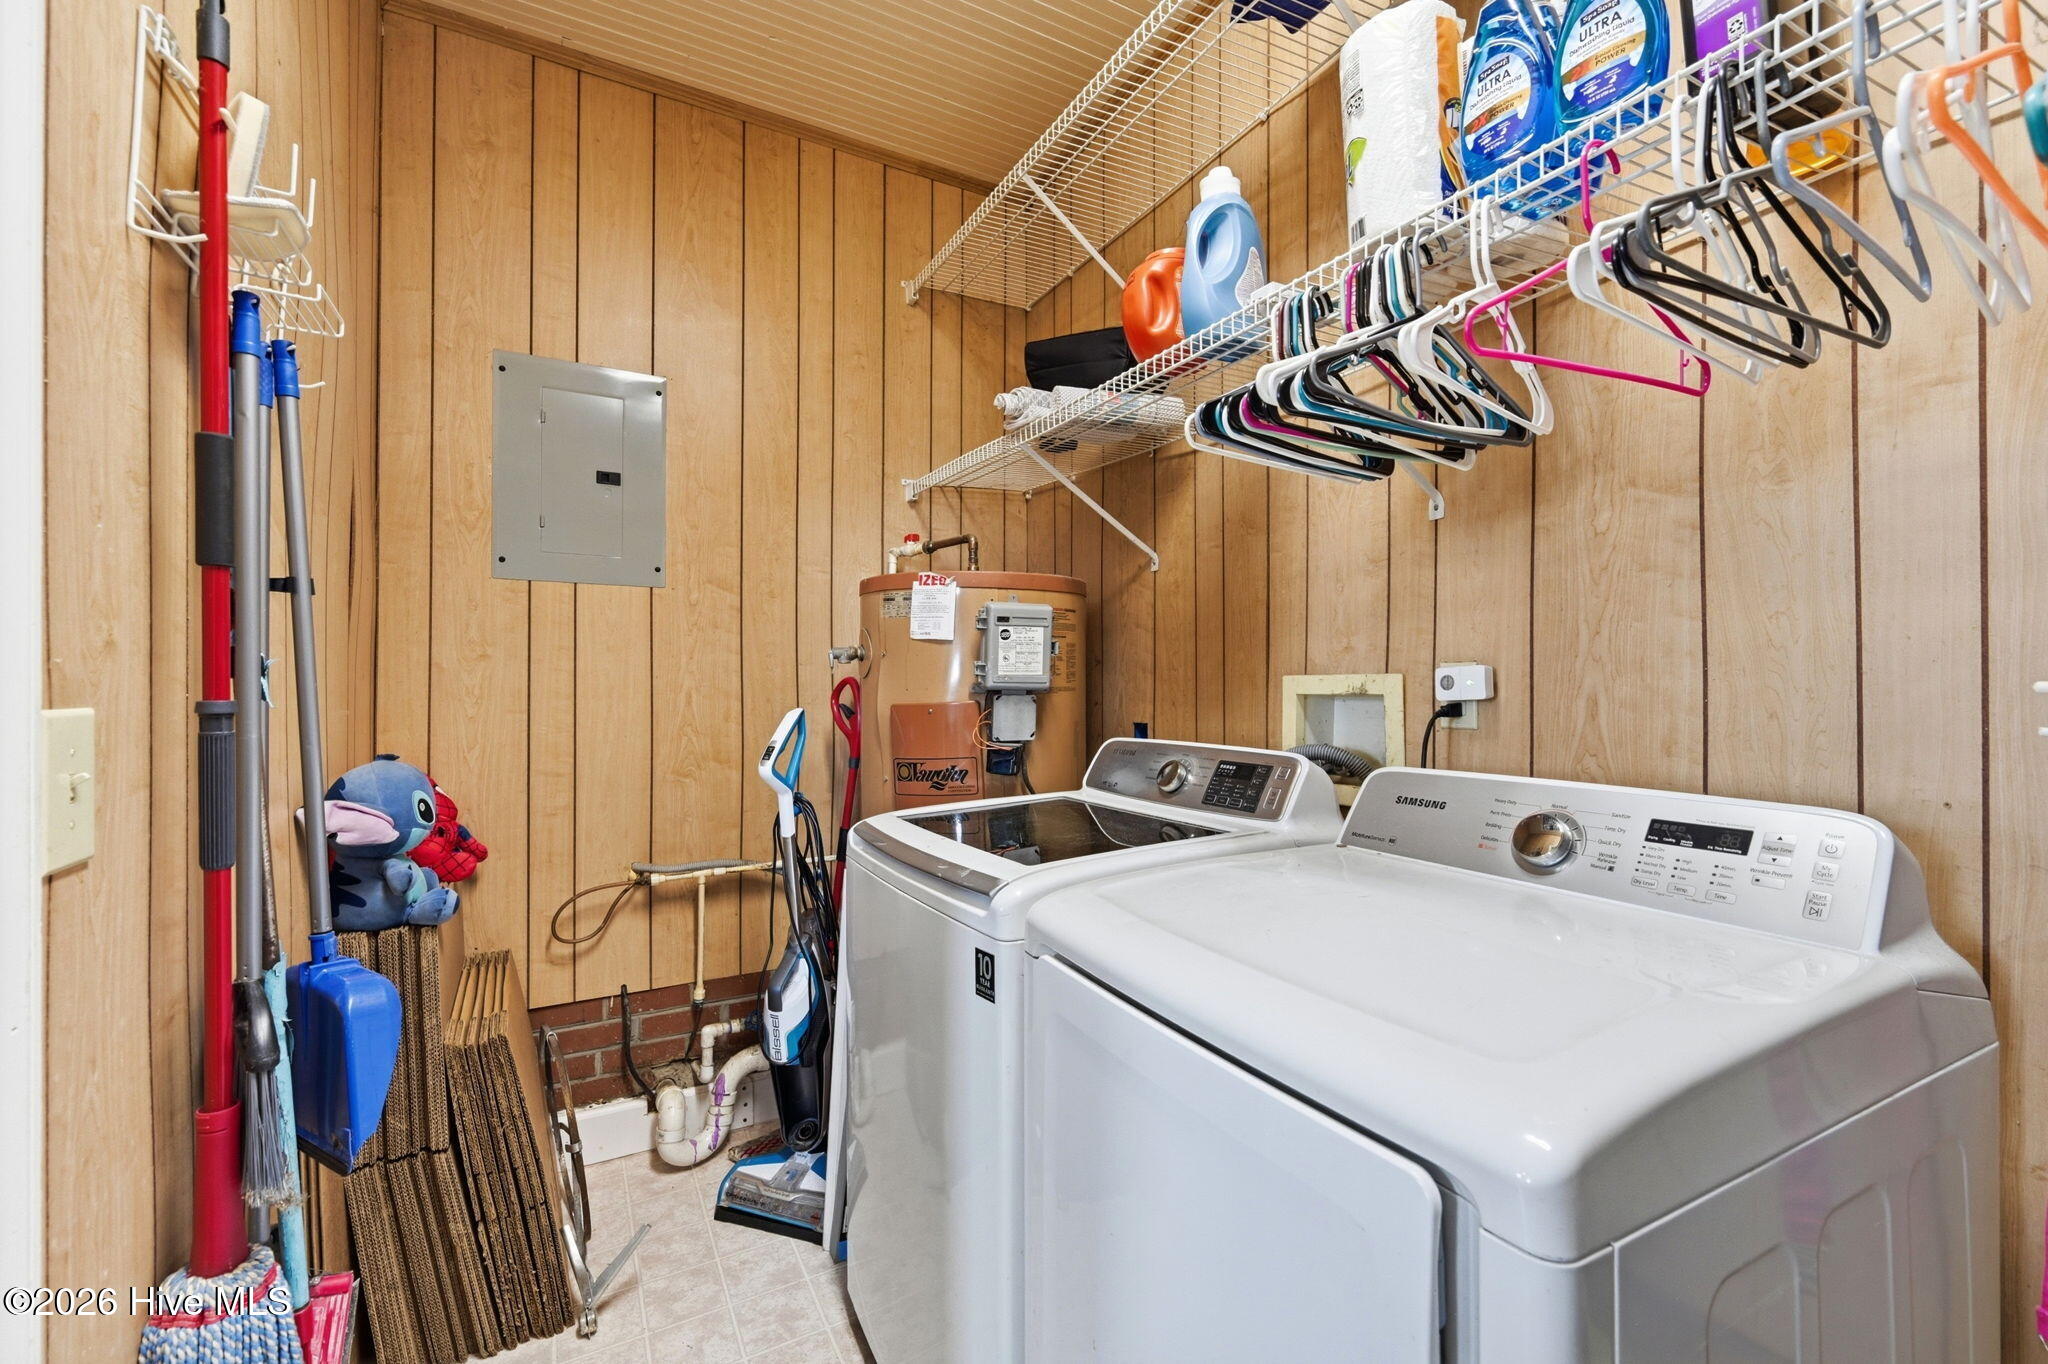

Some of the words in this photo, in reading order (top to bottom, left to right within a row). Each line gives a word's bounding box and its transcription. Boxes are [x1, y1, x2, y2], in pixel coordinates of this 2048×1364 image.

[1579, 11, 1622, 43] ULTRA
[1612, 16, 1635, 32] Liquid
[1594, 47, 1626, 67] POWER
[1477, 69, 1511, 97] ULTRA
[1502, 74, 1522, 88] Liquid
[1489, 102, 1515, 118] POWER
[1395, 795, 1447, 810] SAMSUNG
[1633, 878, 1642, 886] Dry
[1816, 870, 1833, 878] Cycle
[1808, 899, 1827, 907] Pause
[978, 953, 992, 980] 10
